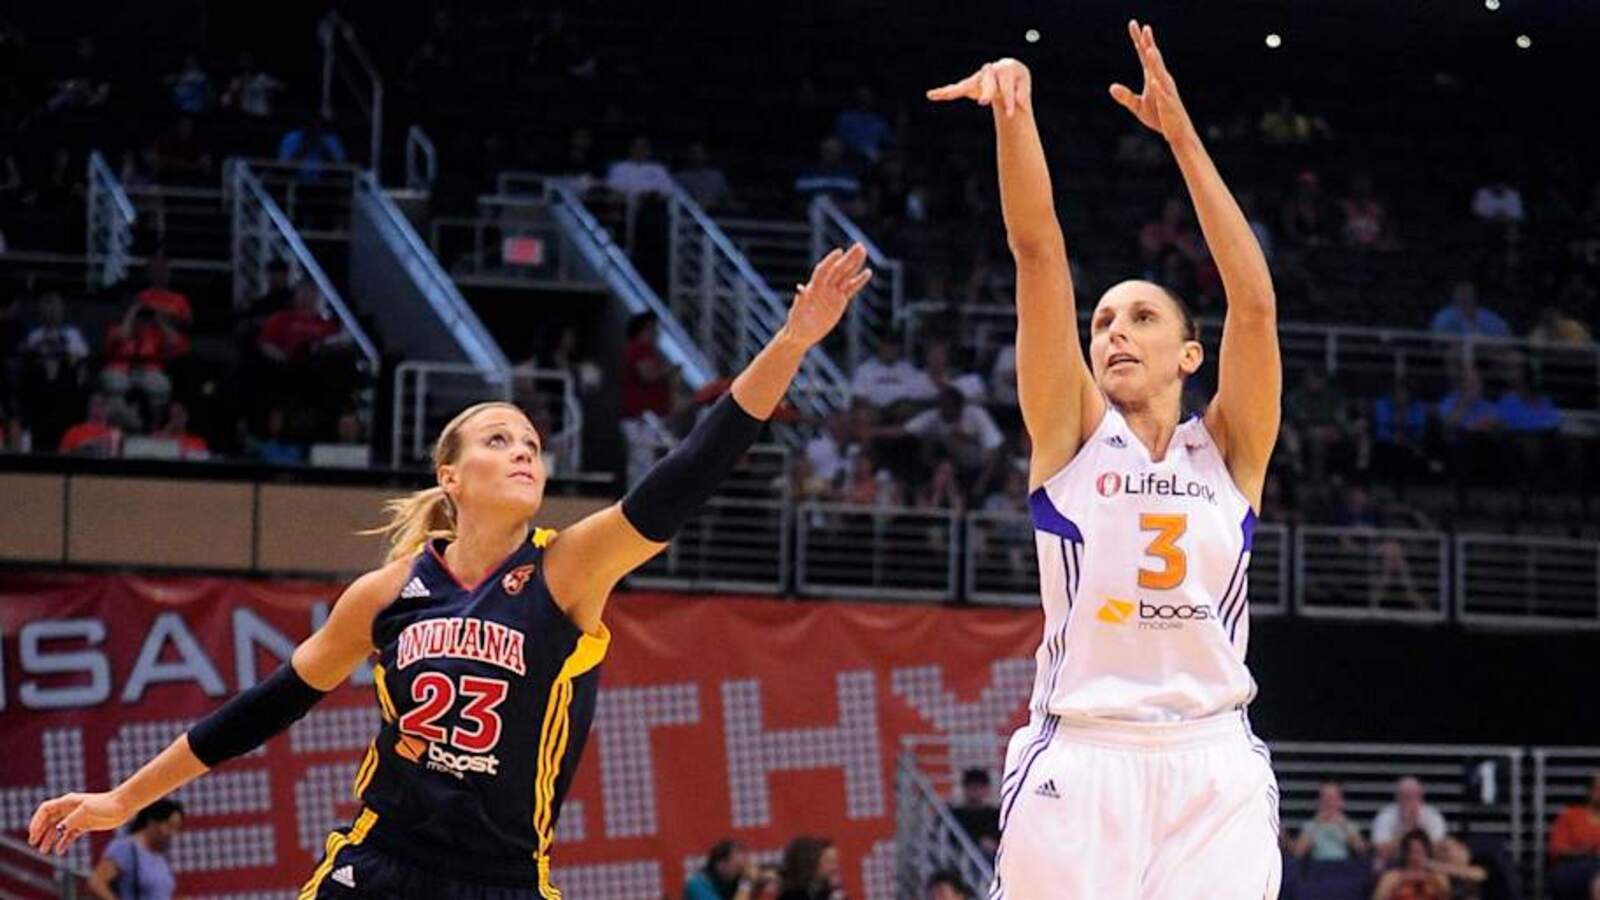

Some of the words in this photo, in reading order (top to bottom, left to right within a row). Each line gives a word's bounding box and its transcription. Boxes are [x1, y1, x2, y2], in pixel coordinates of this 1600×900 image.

[1137, 513, 1187, 591] 3
[397, 617, 526, 676] INDIANA
[400, 671, 509, 754] 23
[428, 741, 500, 775] boost
